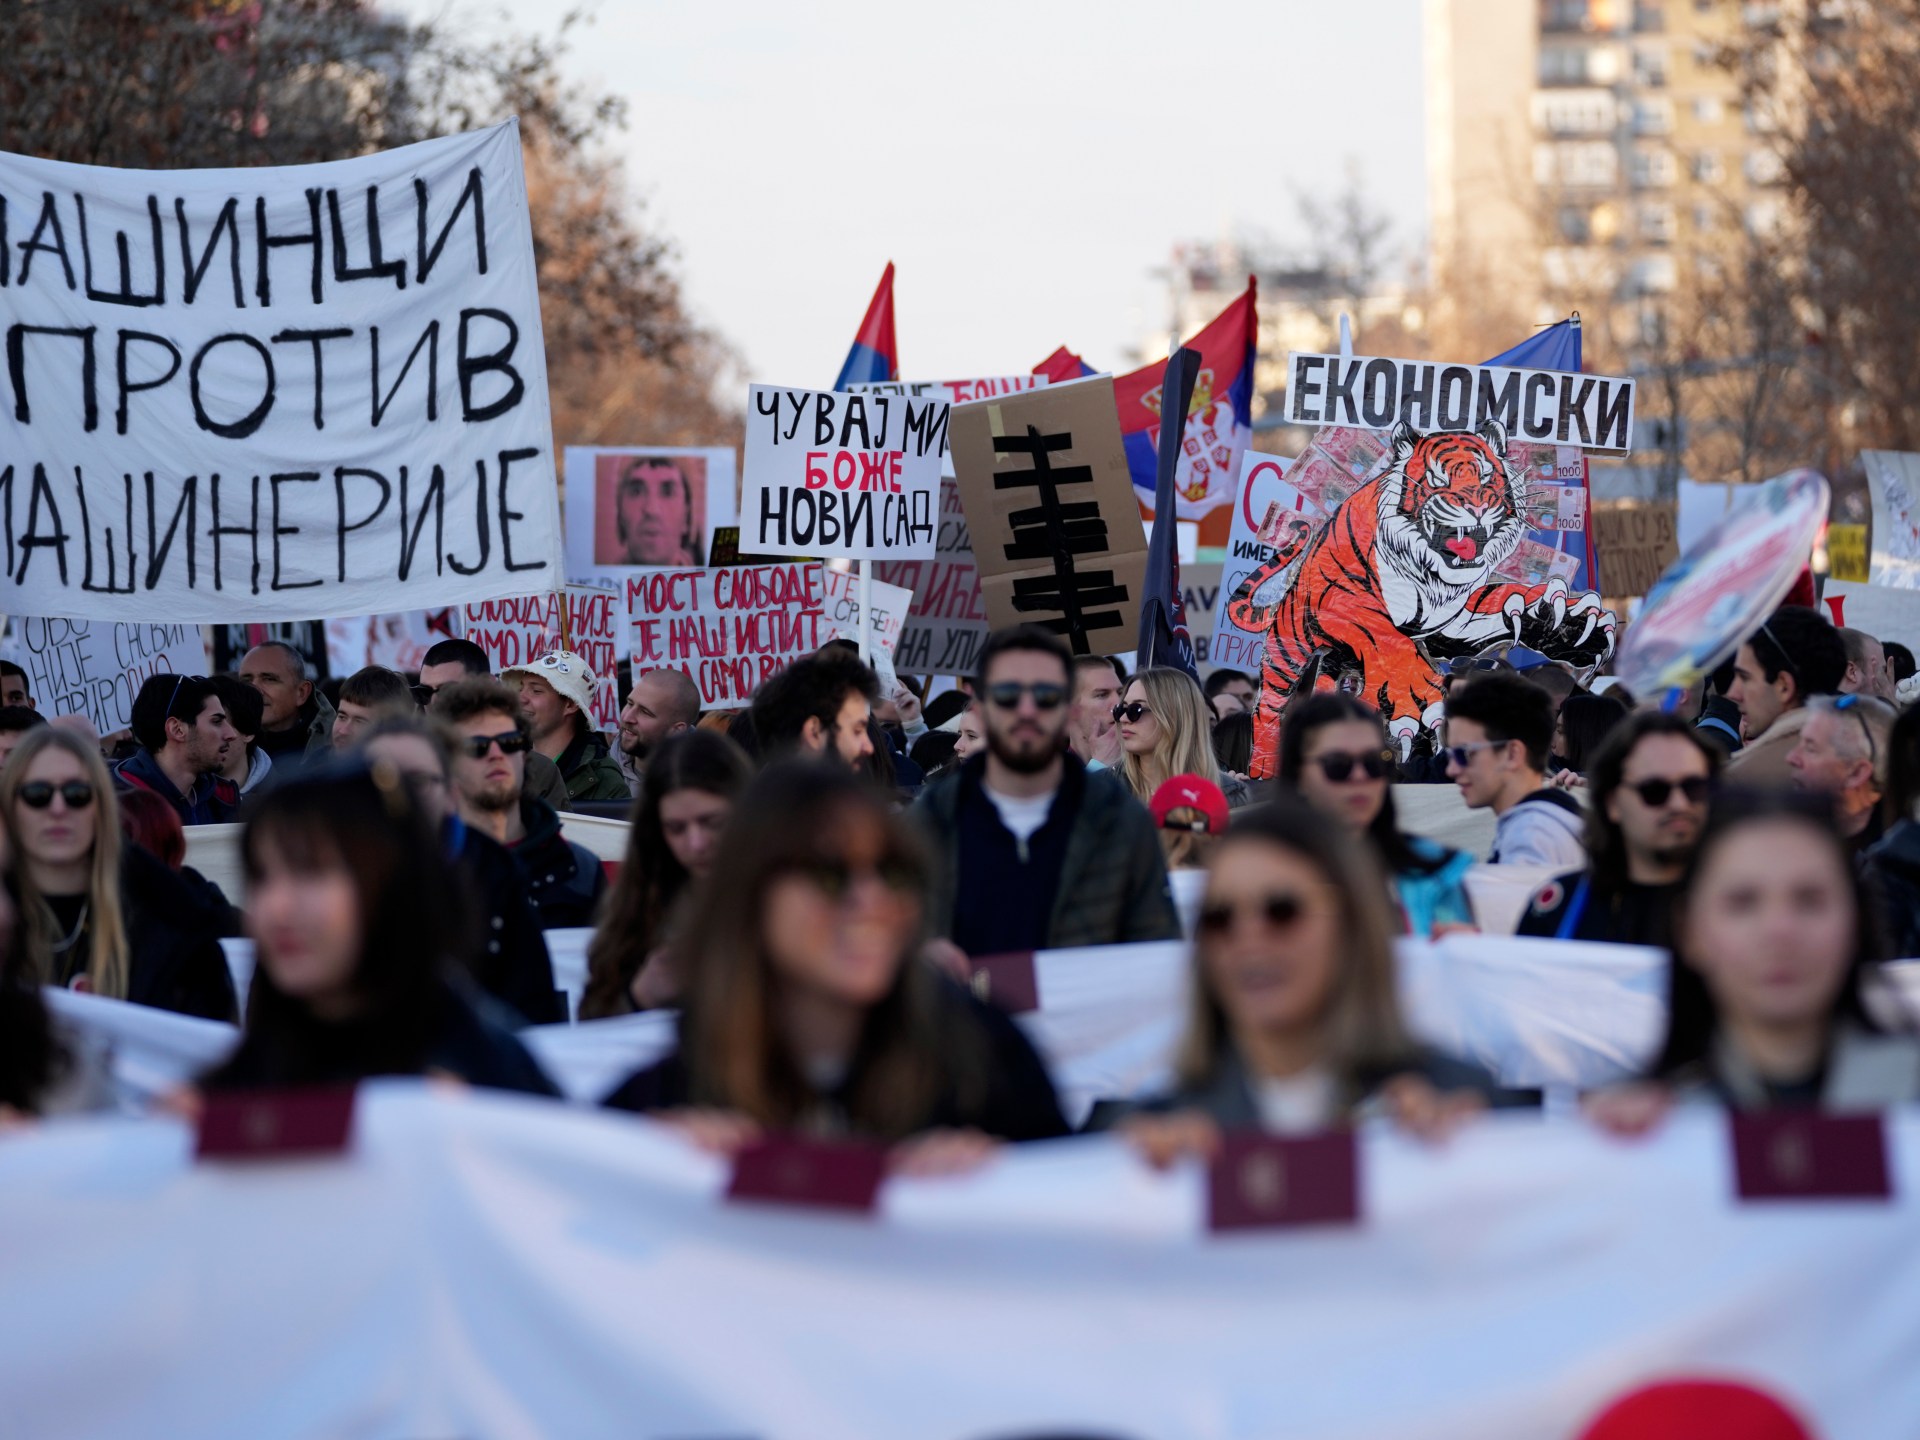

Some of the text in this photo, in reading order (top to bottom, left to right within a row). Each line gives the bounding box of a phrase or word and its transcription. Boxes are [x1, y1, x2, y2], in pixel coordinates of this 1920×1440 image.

[6, 308, 525, 439] ПРОТИВ
[756, 391, 951, 458] ЧУВАЈ МИ
[1293, 356, 1632, 449] ЕКОНОМСКИ
[805, 451, 904, 493] БОЖЕ
[1557, 466, 1581, 477] 1000
[759, 486, 873, 548] НОВИ
[883, 490, 933, 547] САД
[1557, 518, 1581, 529] 1000
[1233, 539, 1277, 562] ИМЕ
[627, 571, 706, 615] МОСТ
[713, 564, 824, 612] СЛОБОДЕ
[568, 592, 618, 638] НИЈЕ
[632, 619, 664, 664] ЈЕ
[669, 614, 728, 662] НАШ
[734, 609, 825, 655] ИСПИТ
[29, 634, 98, 705] НИЈЕ
[895, 627, 990, 671] НА УЛИ
[1214, 633, 1262, 668] ПРИС
[699, 655, 753, 703] САМО
